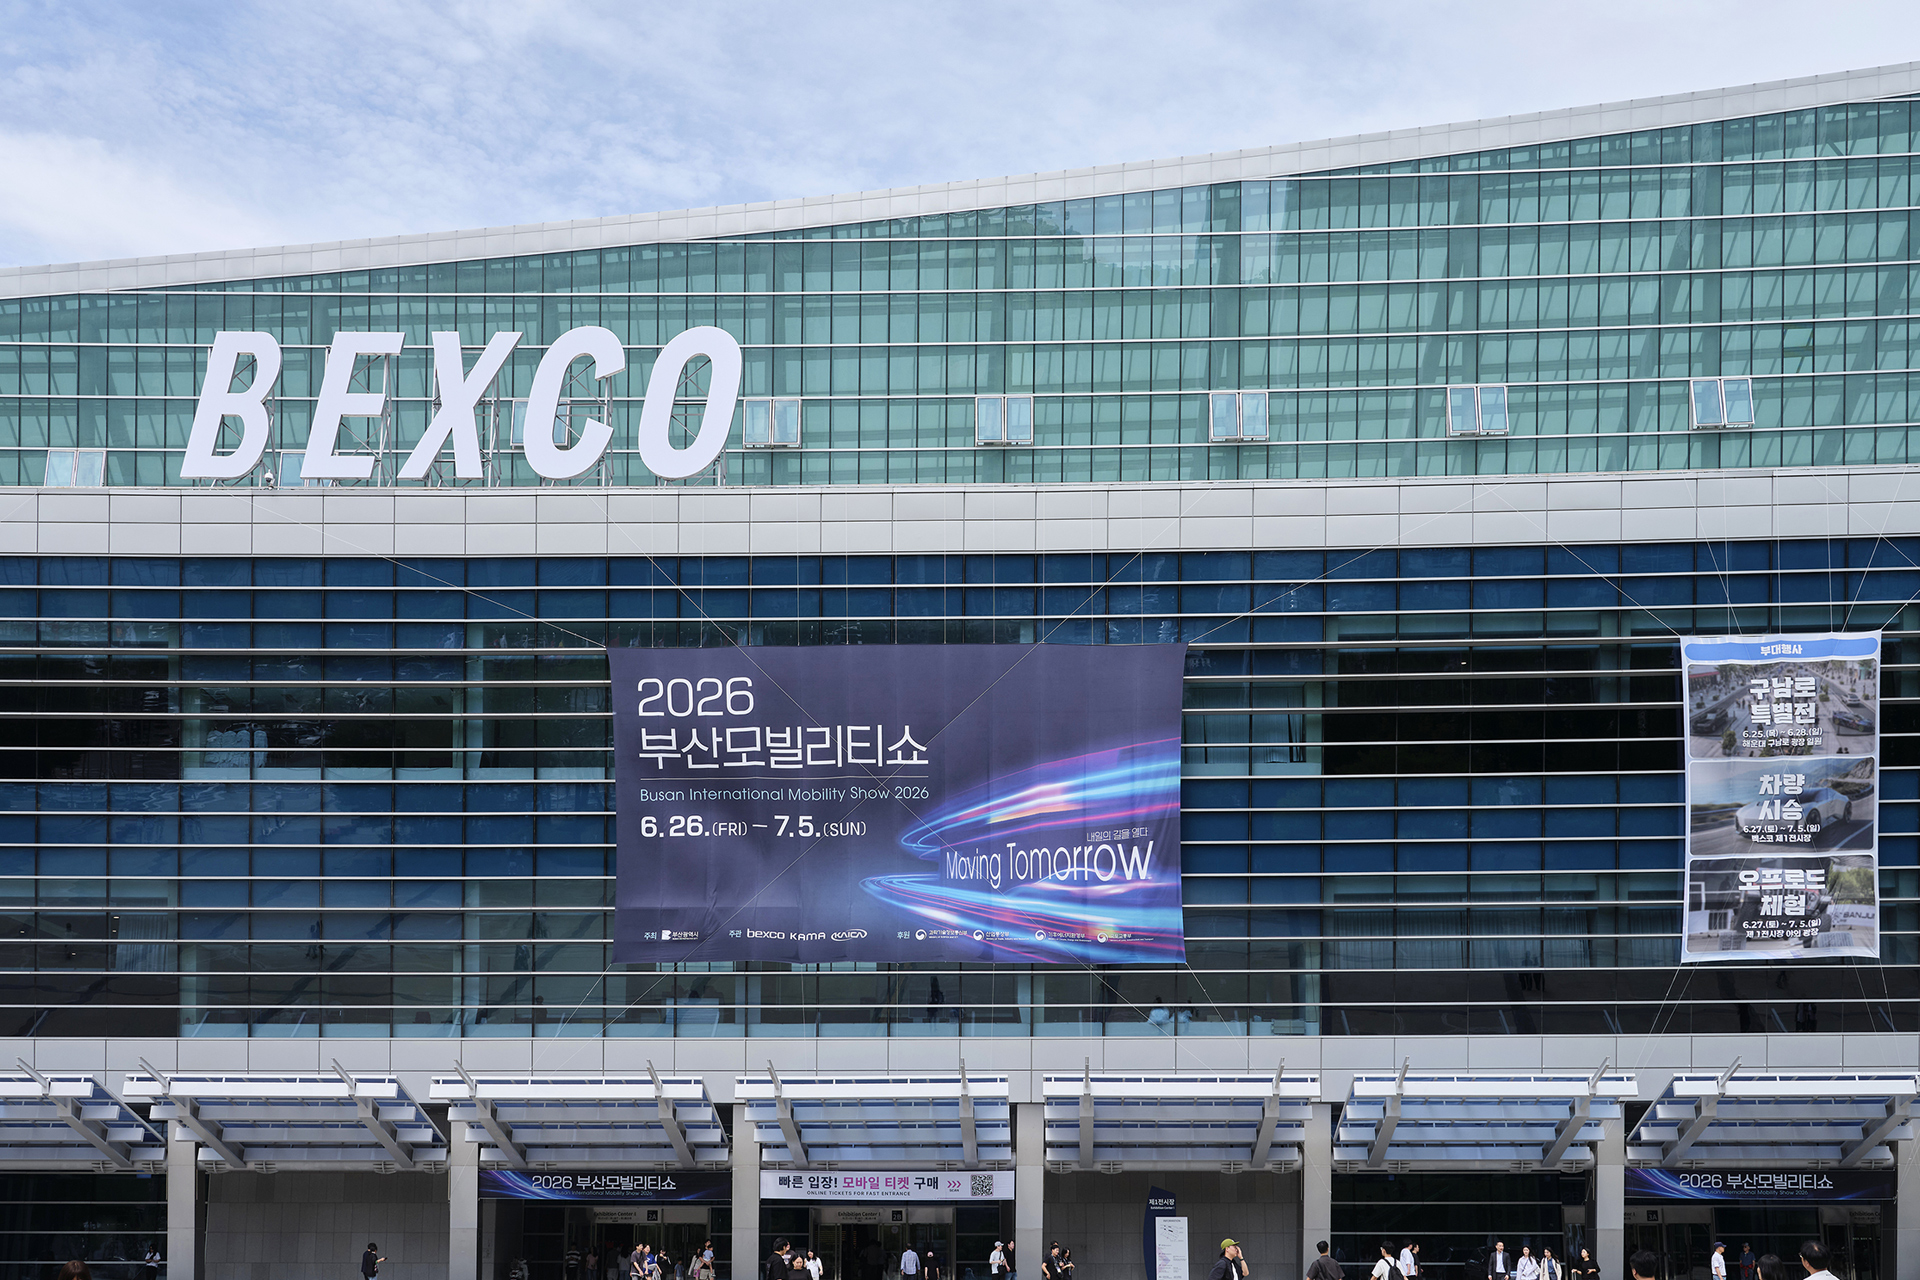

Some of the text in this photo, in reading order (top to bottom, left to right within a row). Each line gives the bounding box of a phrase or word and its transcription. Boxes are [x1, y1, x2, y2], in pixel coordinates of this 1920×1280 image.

[180, 325, 743, 480] BEXCO
[1760, 644, 1802, 656] 부대행사
[1750, 676, 1816, 700] 구남로
[637, 676, 755, 718] 2026
[1750, 702, 1816, 726] 특별전
[1742, 729, 1779, 738] 6.25.(목)
[1788, 728, 1823, 737] 6.28.(일)
[638, 724, 929, 770] 부산모빌리티쇼
[1742, 737, 1822, 748] 해운대 구남로 광장 일원
[1758, 774, 1806, 795] 차량
[640, 786, 930, 802] Busan International Mobility Show 2026
[1758, 799, 1803, 820] 시승
[1086, 830, 1112, 842] 내일의
[1132, 826, 1148, 838] 열다
[1743, 824, 1778, 834] 6.27.(토)
[1752, 835, 1774, 843] 벡스코
[946, 840, 1154, 889] Moving Tomorrow
[1738, 869, 1826, 891] 오프로드
[1760, 894, 1806, 916] 체험
[1742, 920, 1779, 929] 6.27.(토)
[644, 931, 657, 940] 주최
[729, 929, 742, 938] 주관
[746, 928, 785, 940] bexco
[790, 932, 826, 941] KAMA
[832, 930, 867, 940] KAICA
[897, 930, 910, 940] 후원
[1786, 929, 1801, 938] 야외
[1803, 928, 1819, 937] 광장
[532, 1175, 676, 1191] 2026 부산모빌리티쇼
[778, 1176, 939, 1190] 빠른 입장! 모바일 티켓 구매
[1679, 1173, 1834, 1190] 2026 부산모빌리티쇼
